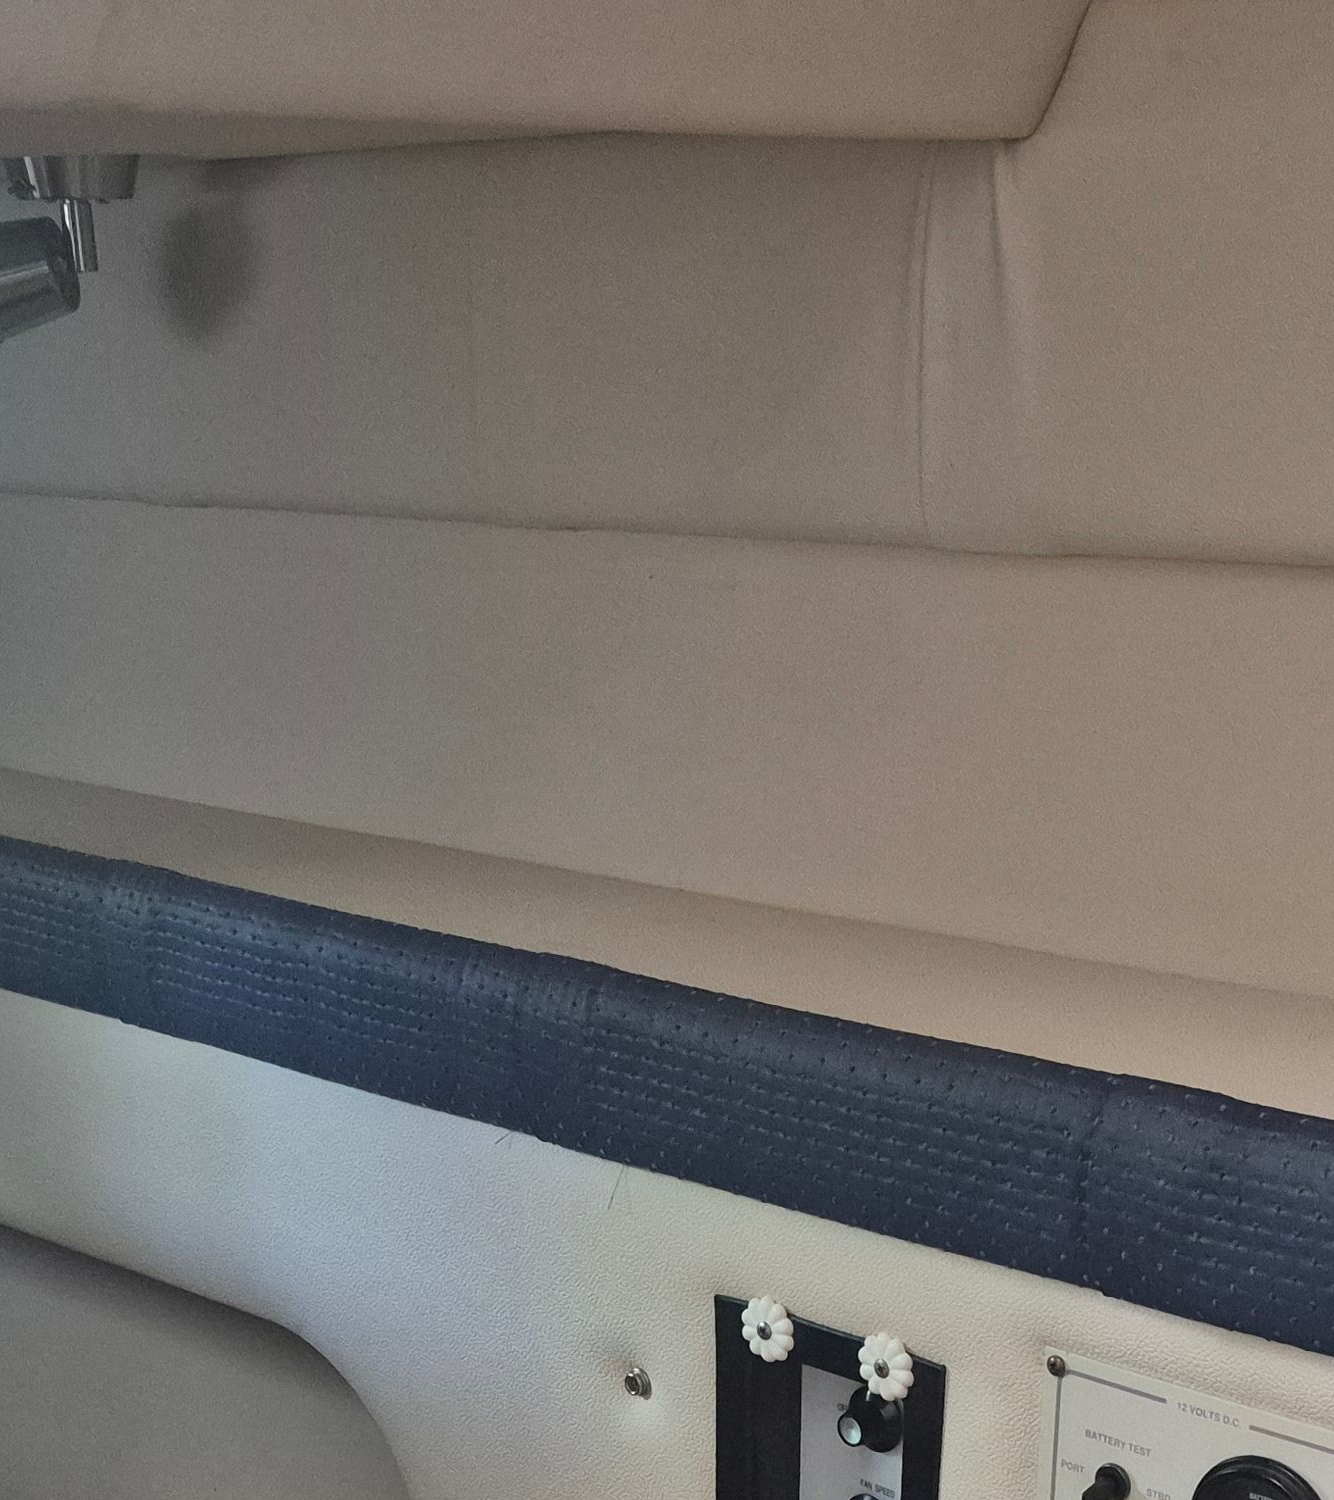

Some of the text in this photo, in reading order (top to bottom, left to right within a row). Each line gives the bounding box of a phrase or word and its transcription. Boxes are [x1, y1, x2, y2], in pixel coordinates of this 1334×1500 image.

[1177, 1402, 1188, 1413] 12
[1189, 1406, 1220, 1422] VOLTS
[1085, 1429, 1151, 1457] BATTERY TEST
[1061, 1459, 1085, 1473] PORT
[875, 1484, 895, 1499] SPEED
